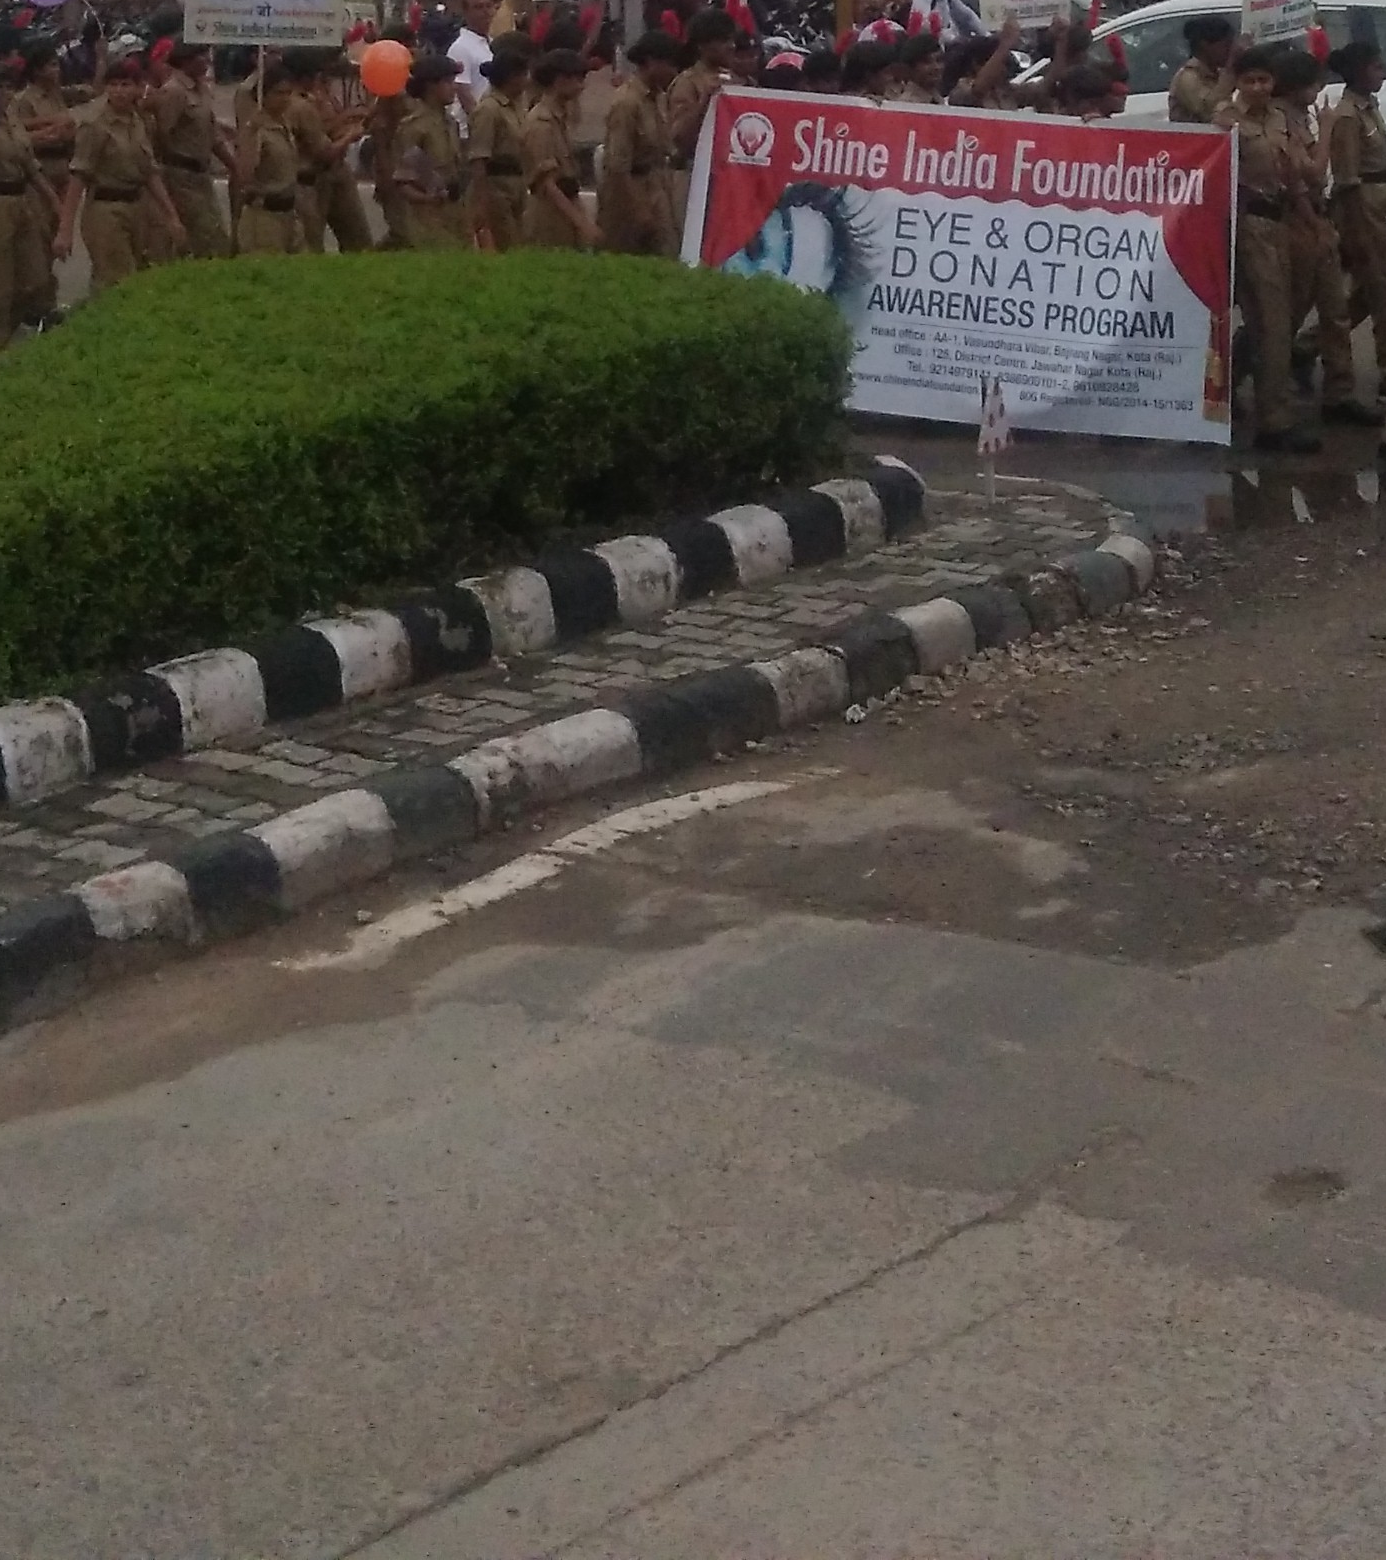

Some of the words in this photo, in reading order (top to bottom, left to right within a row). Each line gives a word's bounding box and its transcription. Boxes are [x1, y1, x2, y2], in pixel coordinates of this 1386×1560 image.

[791, 116, 889, 179] Shine
[903, 130, 998, 190] India
[1012, 139, 1204, 205] Foundation
[895, 207, 974, 245] EYE
[985, 217, 1009, 249] &
[1024, 220, 1158, 262] ORGAN
[891, 247, 1154, 302] DONATION
[867, 284, 1035, 328] AWARENESS
[1044, 303, 1175, 339] PROGRAM
[871, 326, 895, 338] Head
[1107, 367, 1131, 378] Kota
